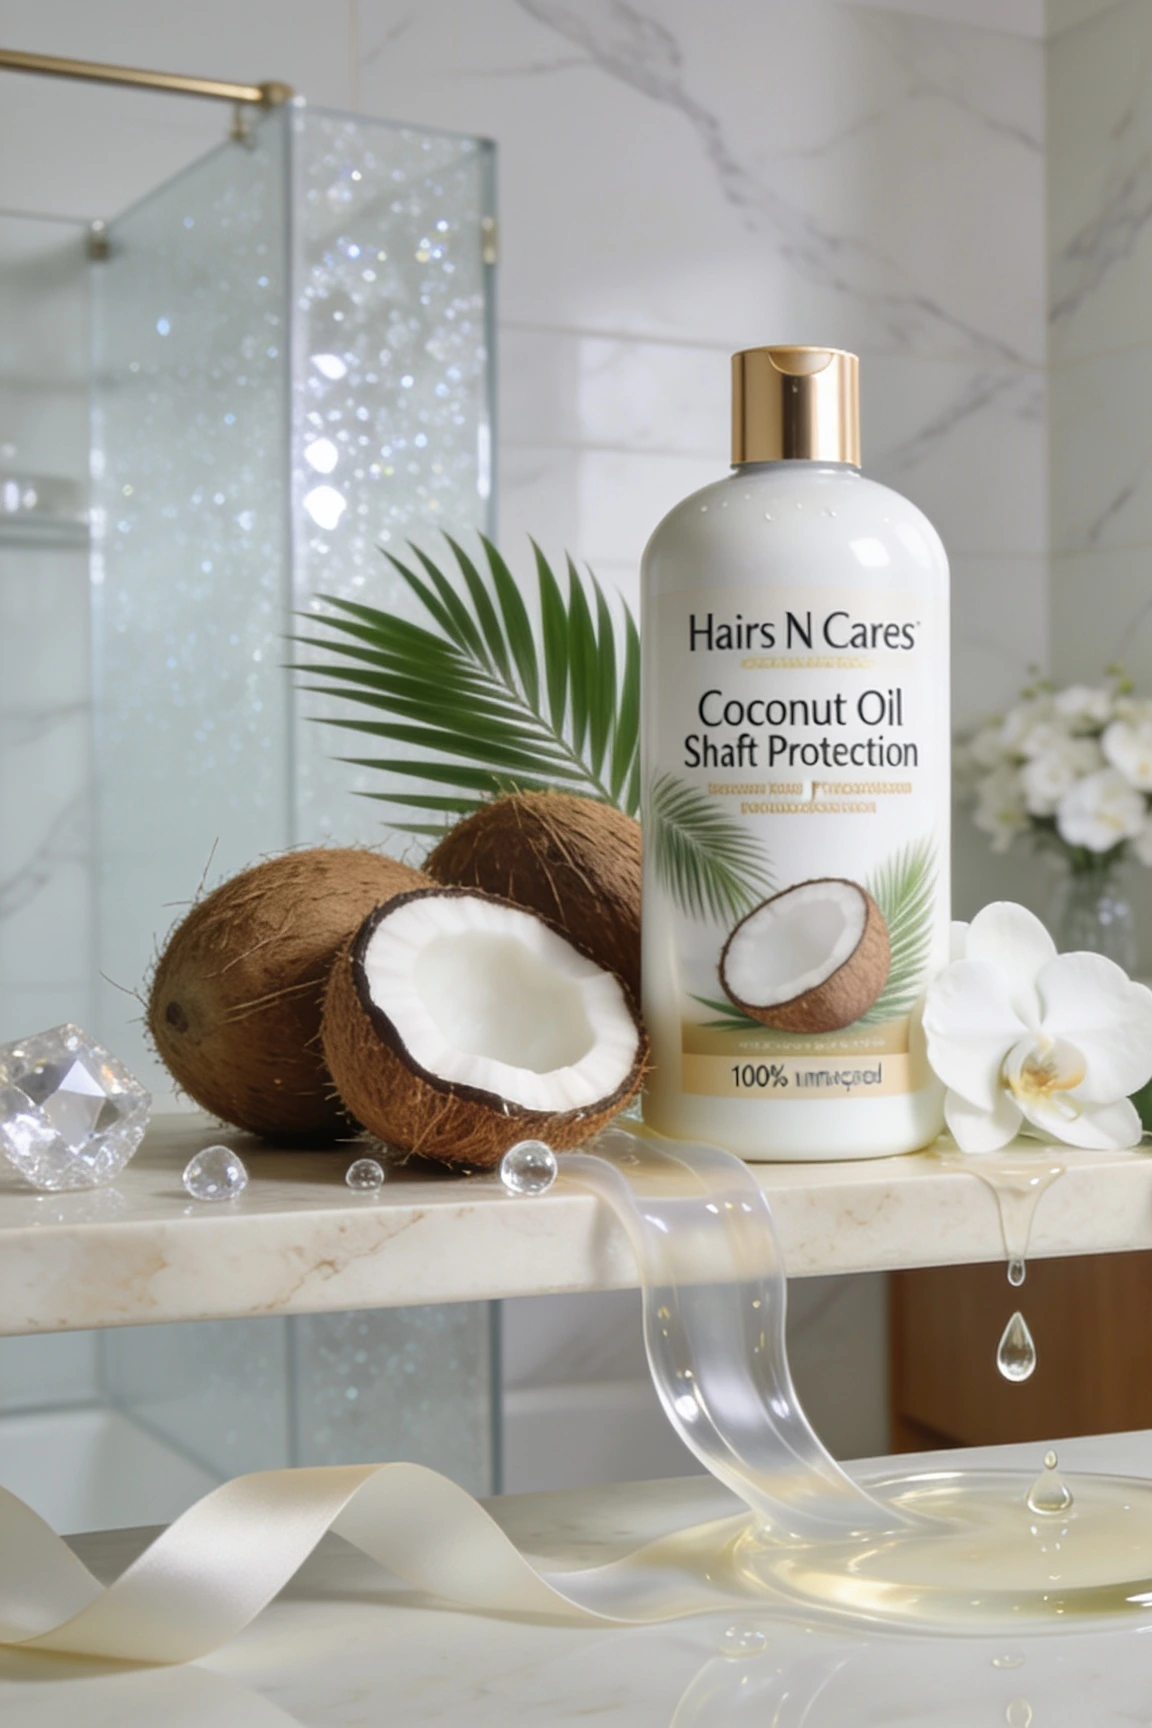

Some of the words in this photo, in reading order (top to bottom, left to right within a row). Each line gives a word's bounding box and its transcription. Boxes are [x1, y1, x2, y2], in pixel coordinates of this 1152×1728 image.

[689, 613, 775, 651] Hairs
[785, 611, 813, 650] N
[698, 689, 847, 727] Coconut
[857, 688, 903, 727] Oil
[684, 733, 758, 768] Shaft
[768, 735, 918, 768] Protection
[731, 1064, 789, 1088] 100%
